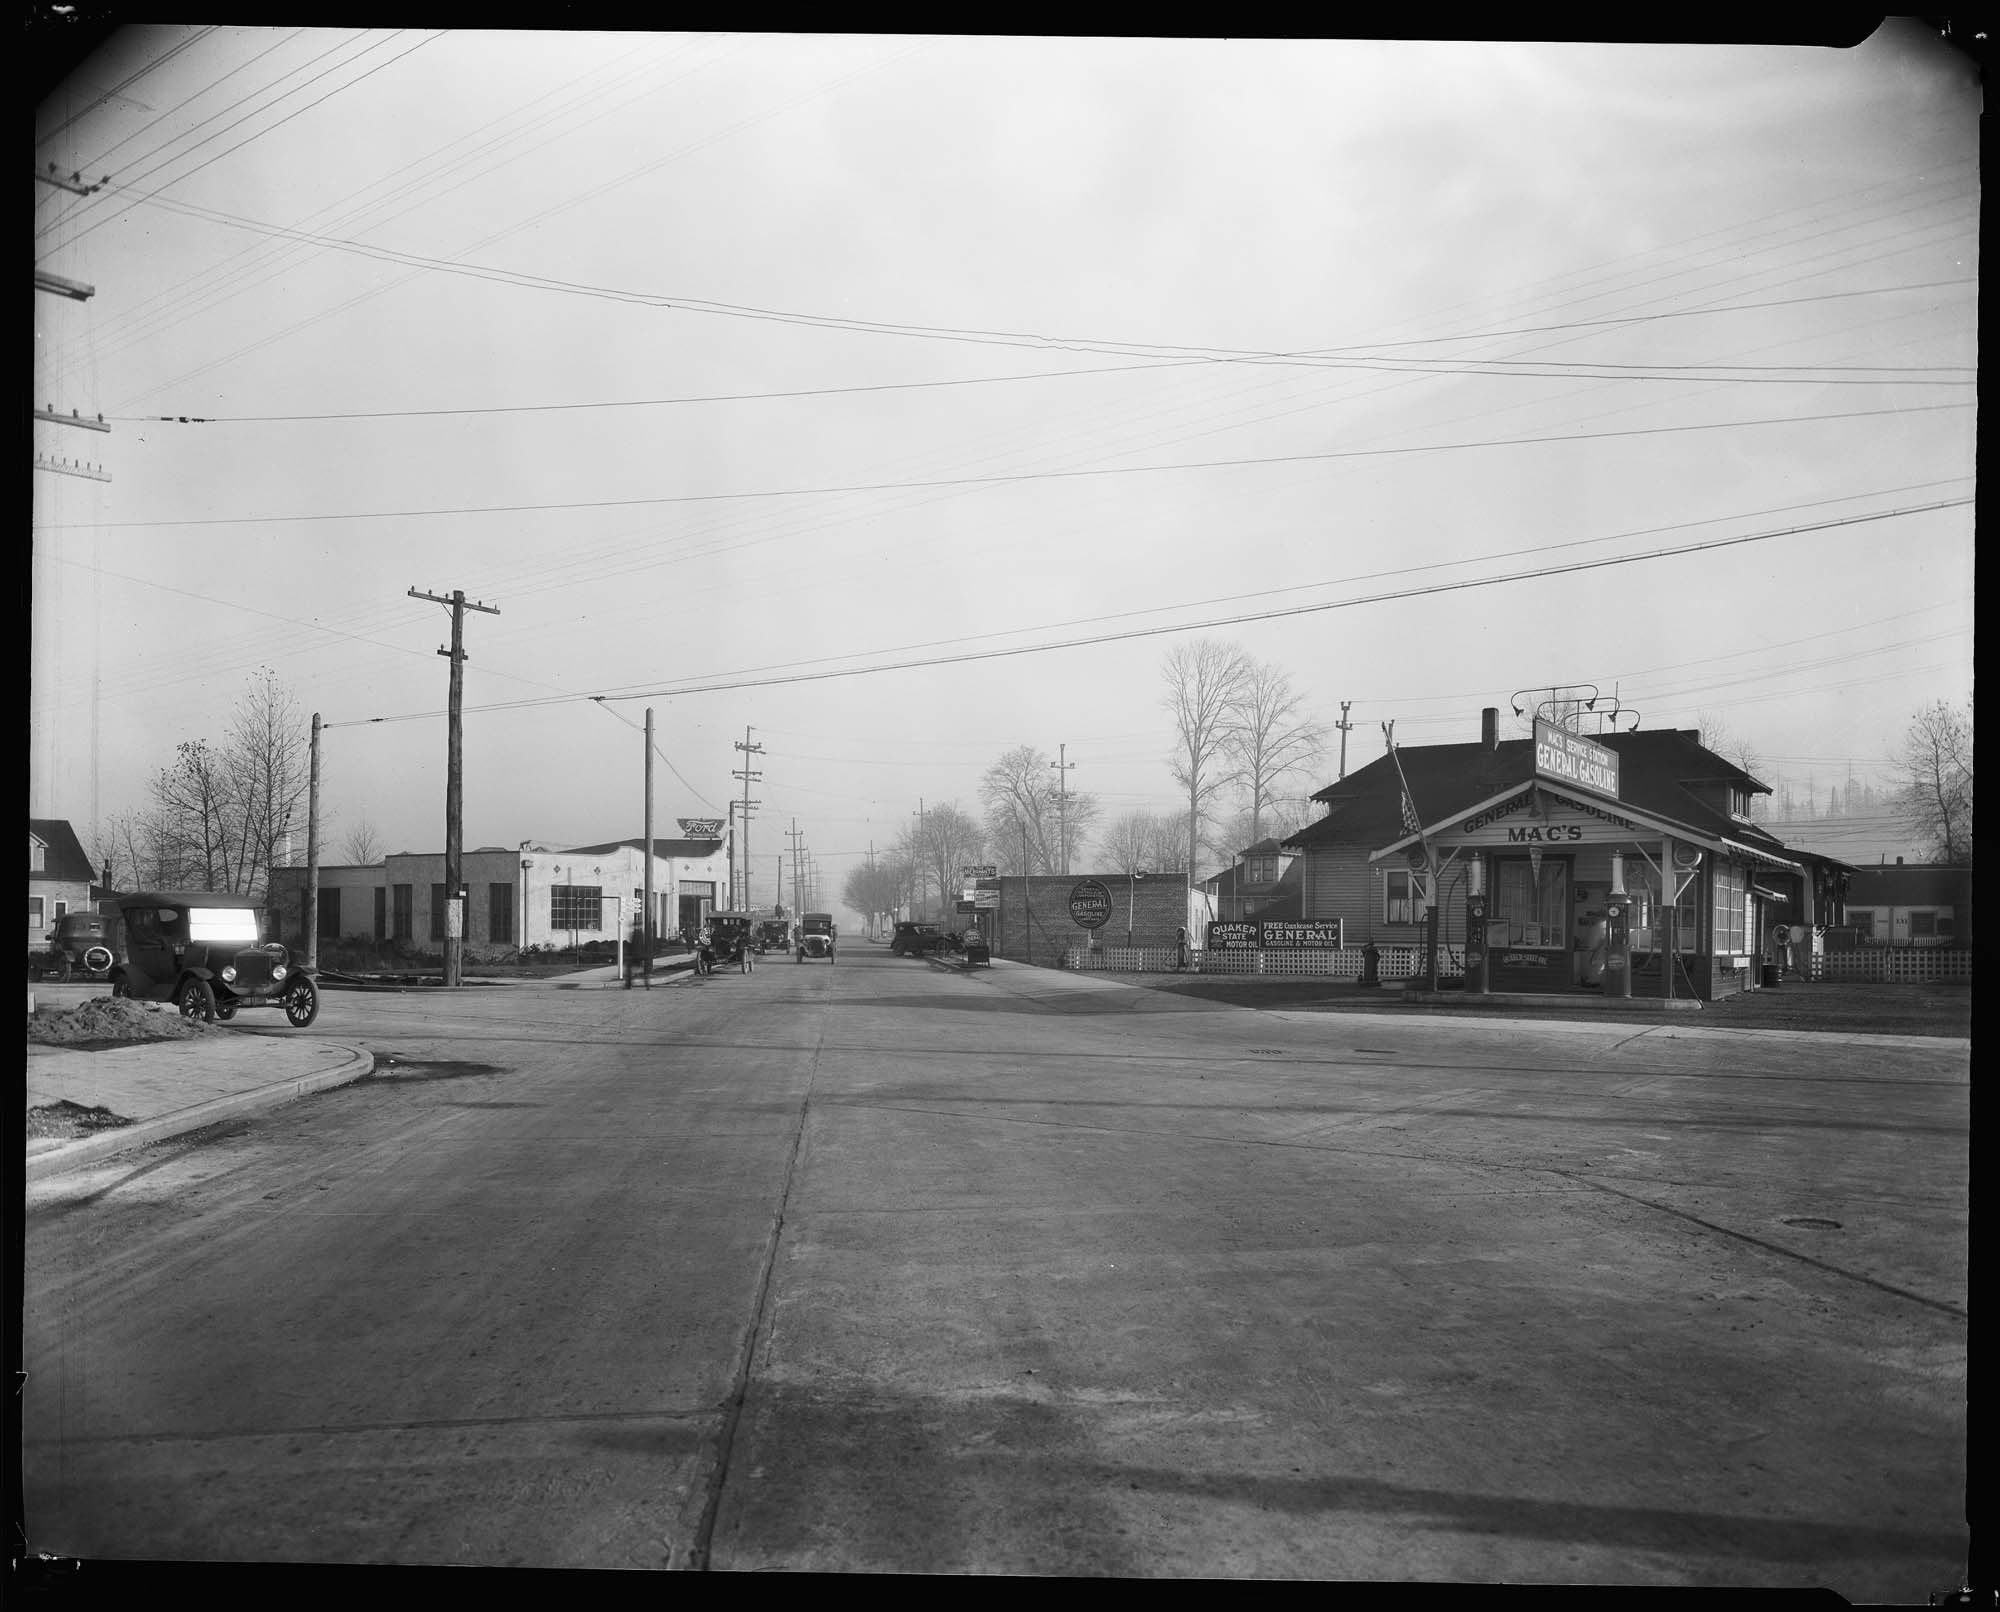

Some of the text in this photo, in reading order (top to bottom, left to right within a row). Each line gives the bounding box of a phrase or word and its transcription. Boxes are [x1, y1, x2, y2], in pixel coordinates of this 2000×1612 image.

[1566, 739, 1587, 758] SERVICE
[1589, 746, 1609, 766] STATION
[1537, 743, 1616, 793] GENERAL GASOLINE
[1463, 794, 1636, 834] GENERAL GASOLINE
[686, 820, 718, 833] Ford
[1508, 824, 1582, 842] MAC'S
[1072, 898, 1108, 911] GENERAL
[1212, 923, 1257, 936] QUAKER
[1263, 922, 1283, 930] FREE
[1314, 921, 1338, 930] Service
[1263, 930, 1337, 940] GENERAL
[1226, 940, 1248, 948] MOTOR
